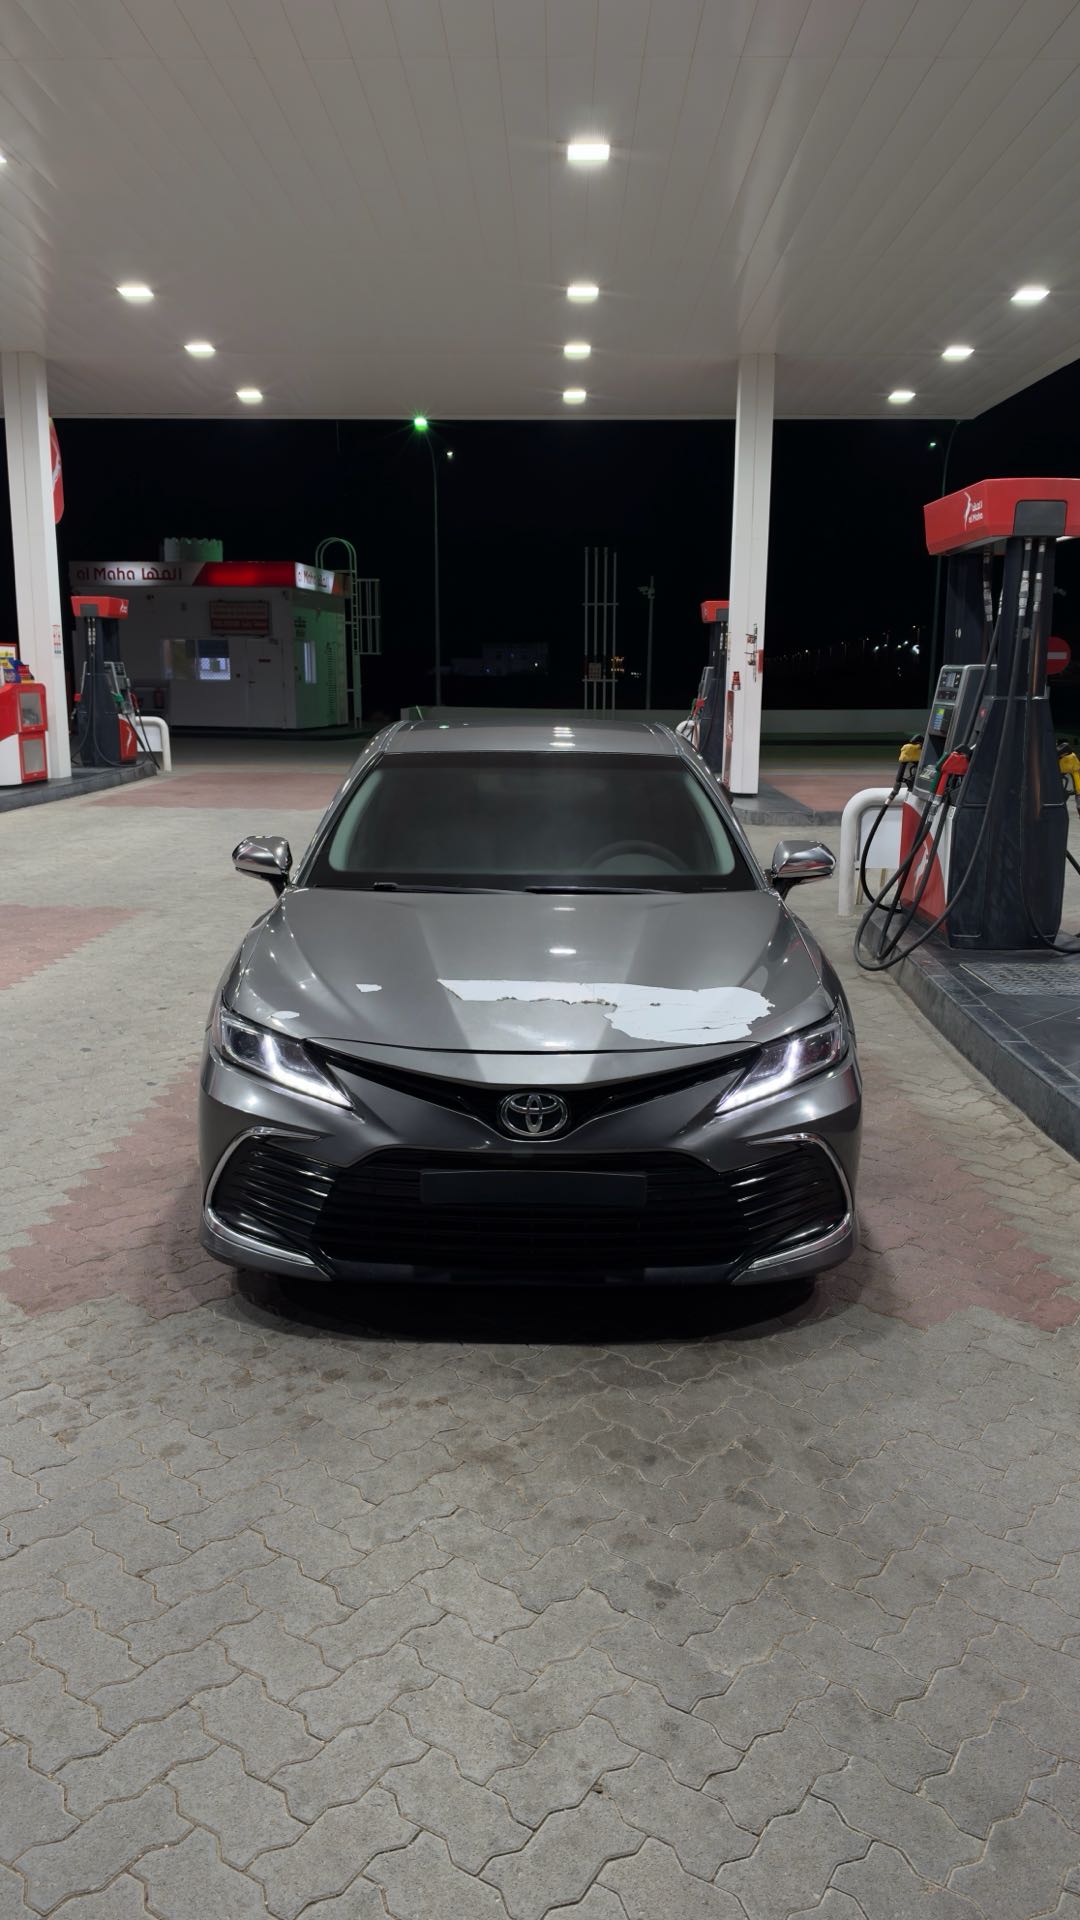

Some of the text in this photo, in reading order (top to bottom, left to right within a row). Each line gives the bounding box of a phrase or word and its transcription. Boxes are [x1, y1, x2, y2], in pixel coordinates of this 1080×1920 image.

[76, 568, 136, 580] al Maha
[141, 567, 182, 581] المها
